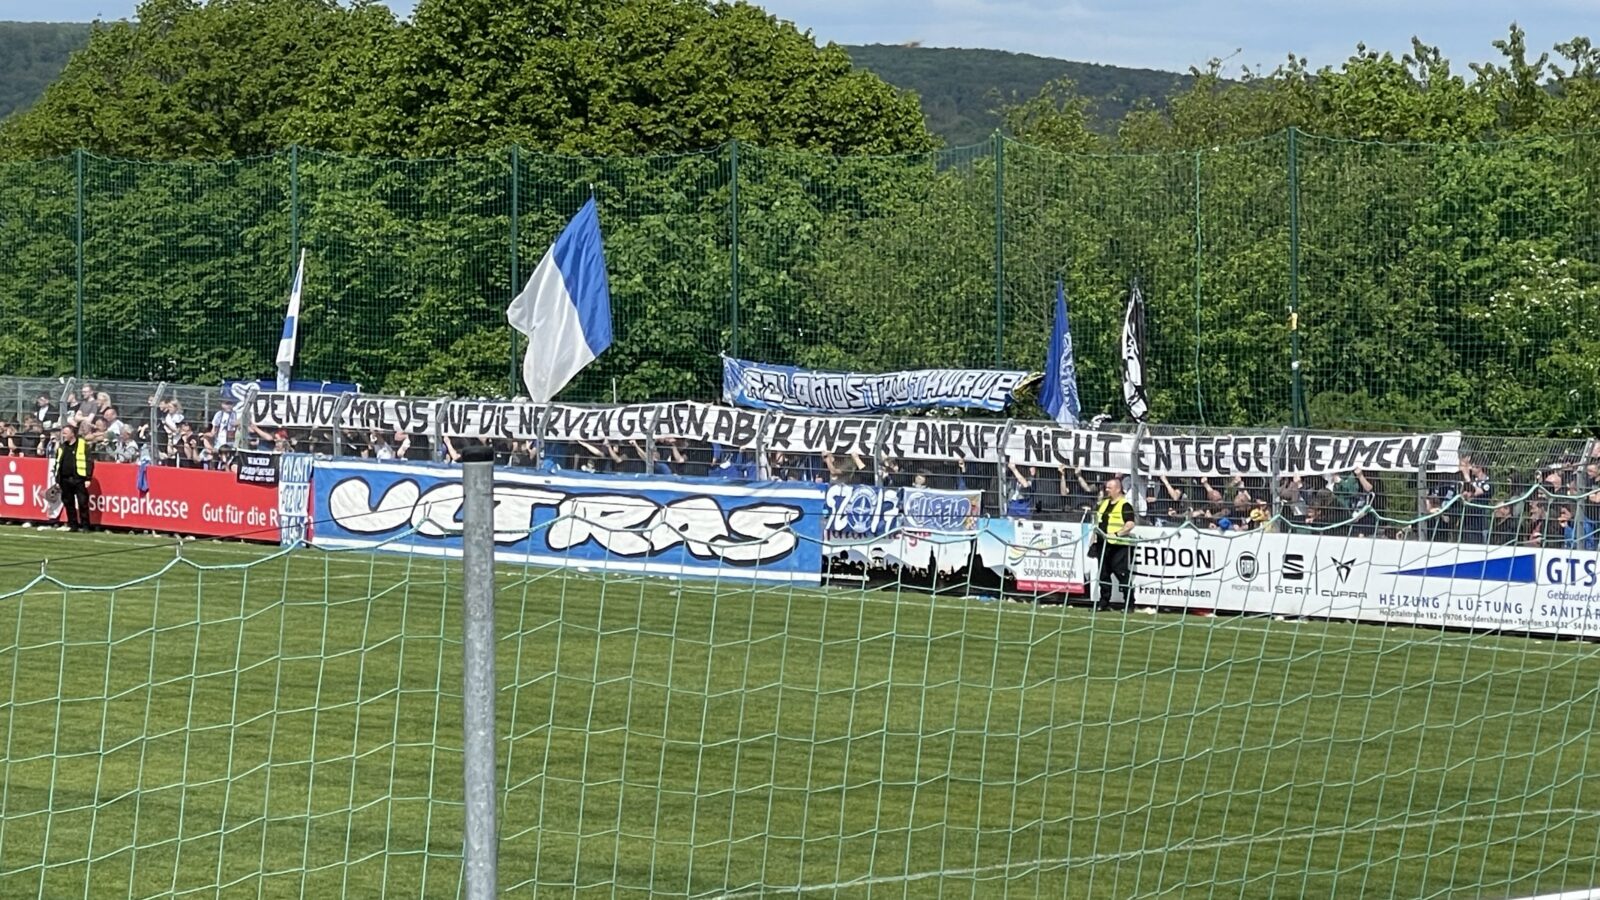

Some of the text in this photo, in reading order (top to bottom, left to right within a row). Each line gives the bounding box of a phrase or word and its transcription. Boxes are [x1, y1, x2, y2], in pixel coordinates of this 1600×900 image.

[253, 394, 301, 425] DEN
[519, 406, 616, 438] NERVEN
[804, 419, 907, 457] UNSERE
[202, 502, 224, 522] Gut
[225, 504, 243, 524] für
[247, 506, 266, 527] die
[1546, 557, 1598, 587] GTS
[1138, 585, 1211, 598] Frankenhausen
[1274, 585, 1311, 595] SEAT
[1321, 589, 1368, 598] CUPRA
[1379, 593, 1440, 609] HEIZUNG
[1458, 597, 1522, 615] LÜFTUNG
